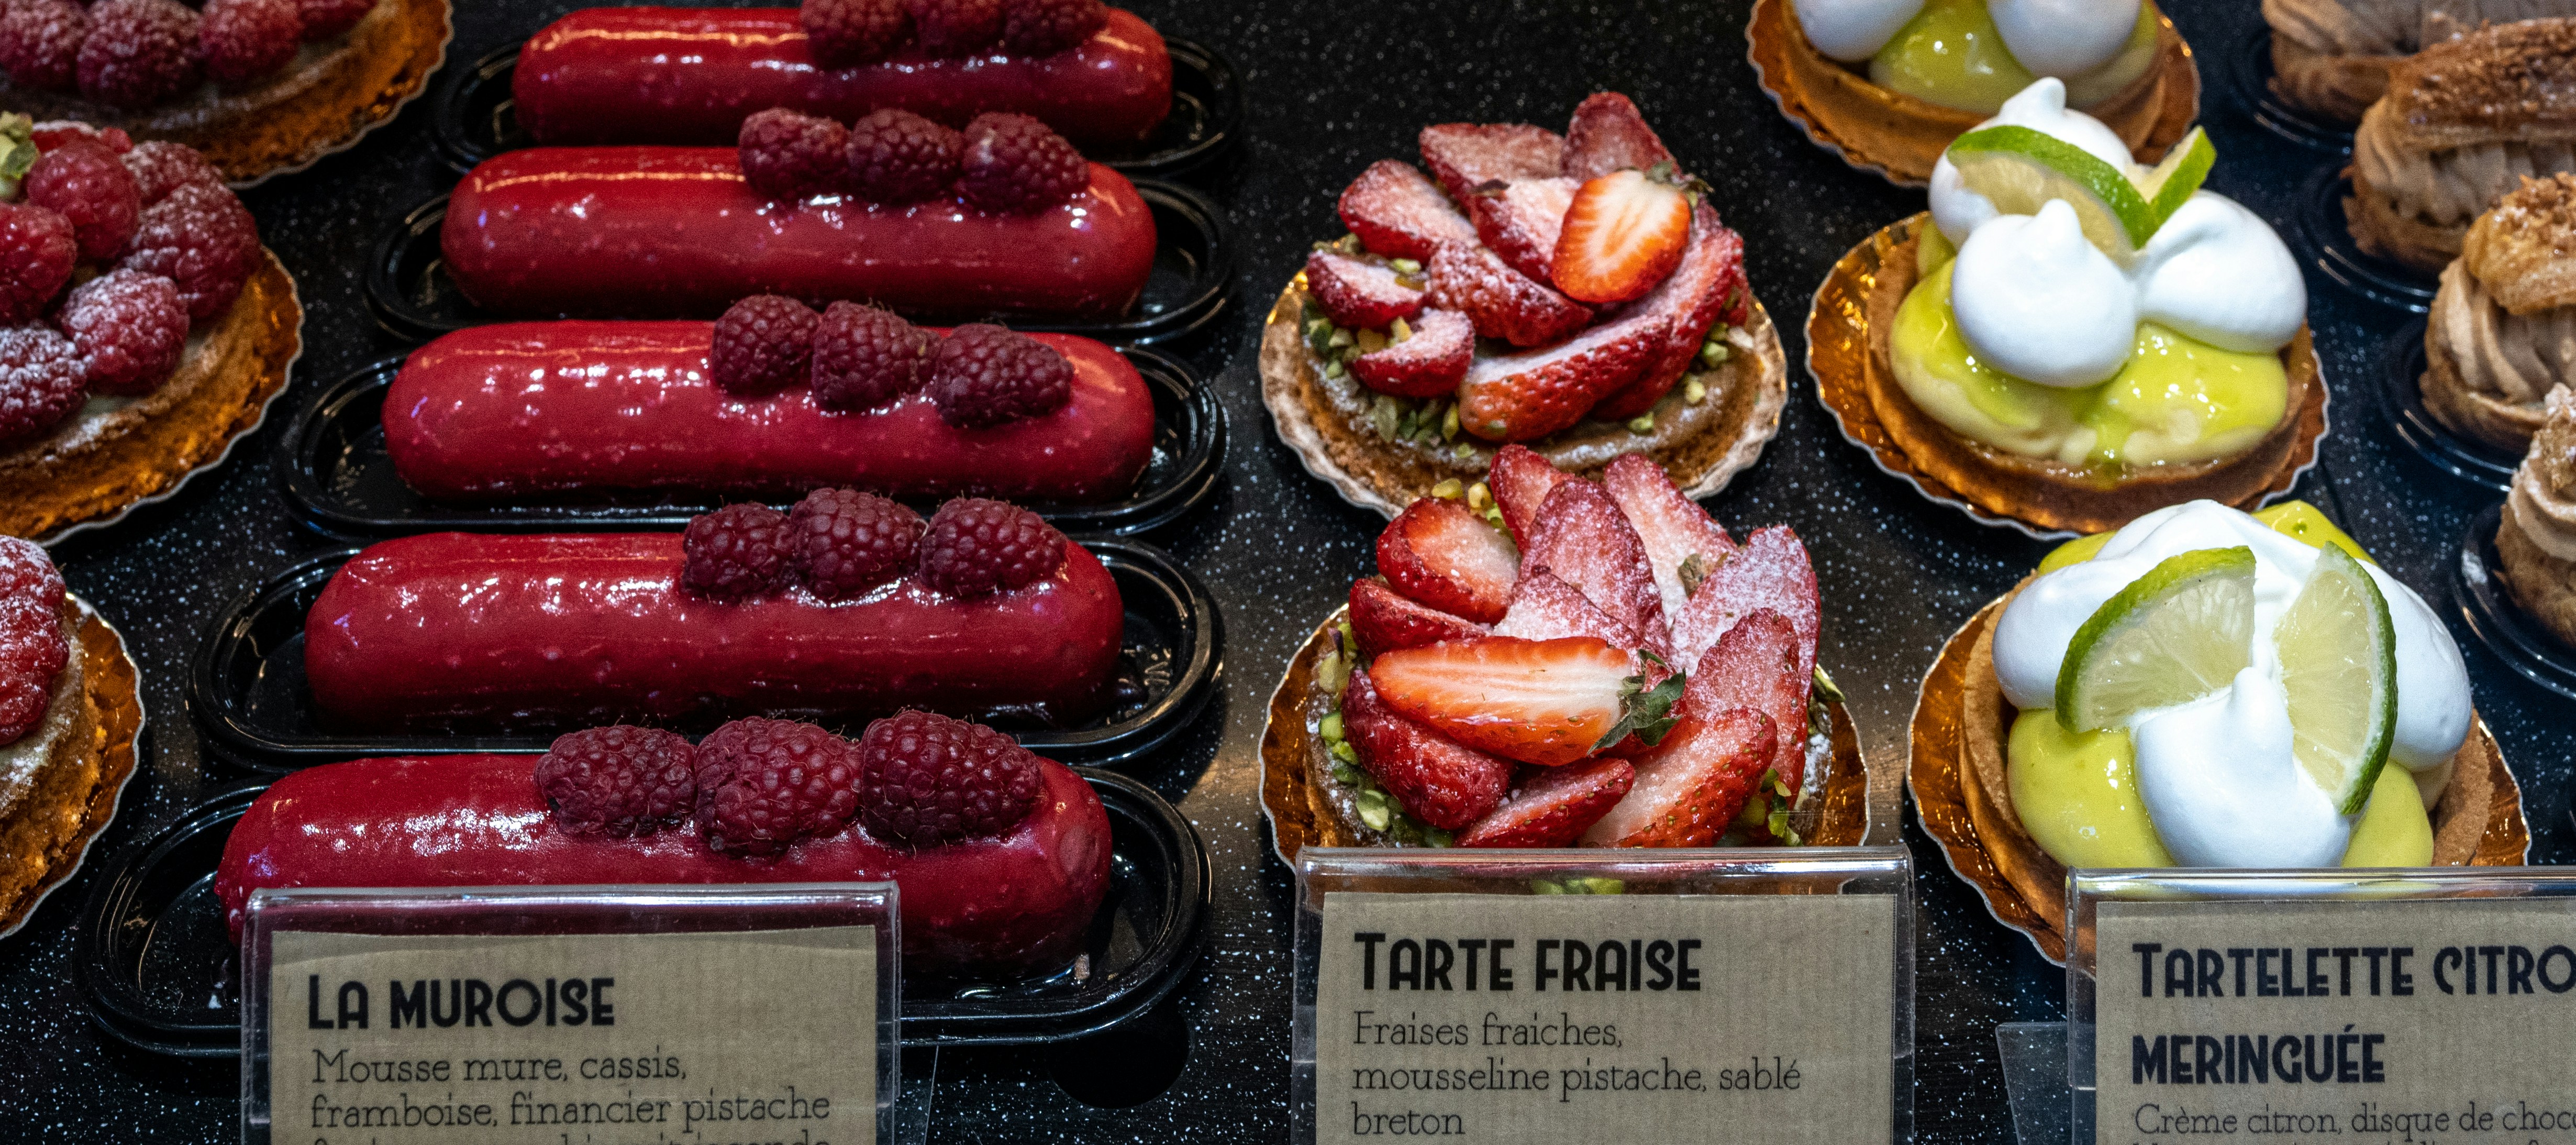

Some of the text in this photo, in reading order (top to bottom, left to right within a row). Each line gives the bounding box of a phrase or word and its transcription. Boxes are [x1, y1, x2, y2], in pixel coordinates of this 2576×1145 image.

[1354, 932, 1702, 991] TARTE FRAISE
[2132, 943, 2576, 997] TARTELETTE CITRO
[308, 975, 615, 1030] LA MUROISE
[1353, 1010, 1622, 1048] Fraises fraiches,
[313, 1046, 687, 1083] Mousse mure, cassis,
[2133, 1024, 2385, 1084] MERINGUÉE
[1351, 1056, 1801, 1103] mousseline pistache, sablé
[312, 1086, 829, 1133] framboise, financier pistache
[1351, 1101, 1465, 1135] breton
[2135, 1100, 2576, 1142] Crème citron, disque de choc
